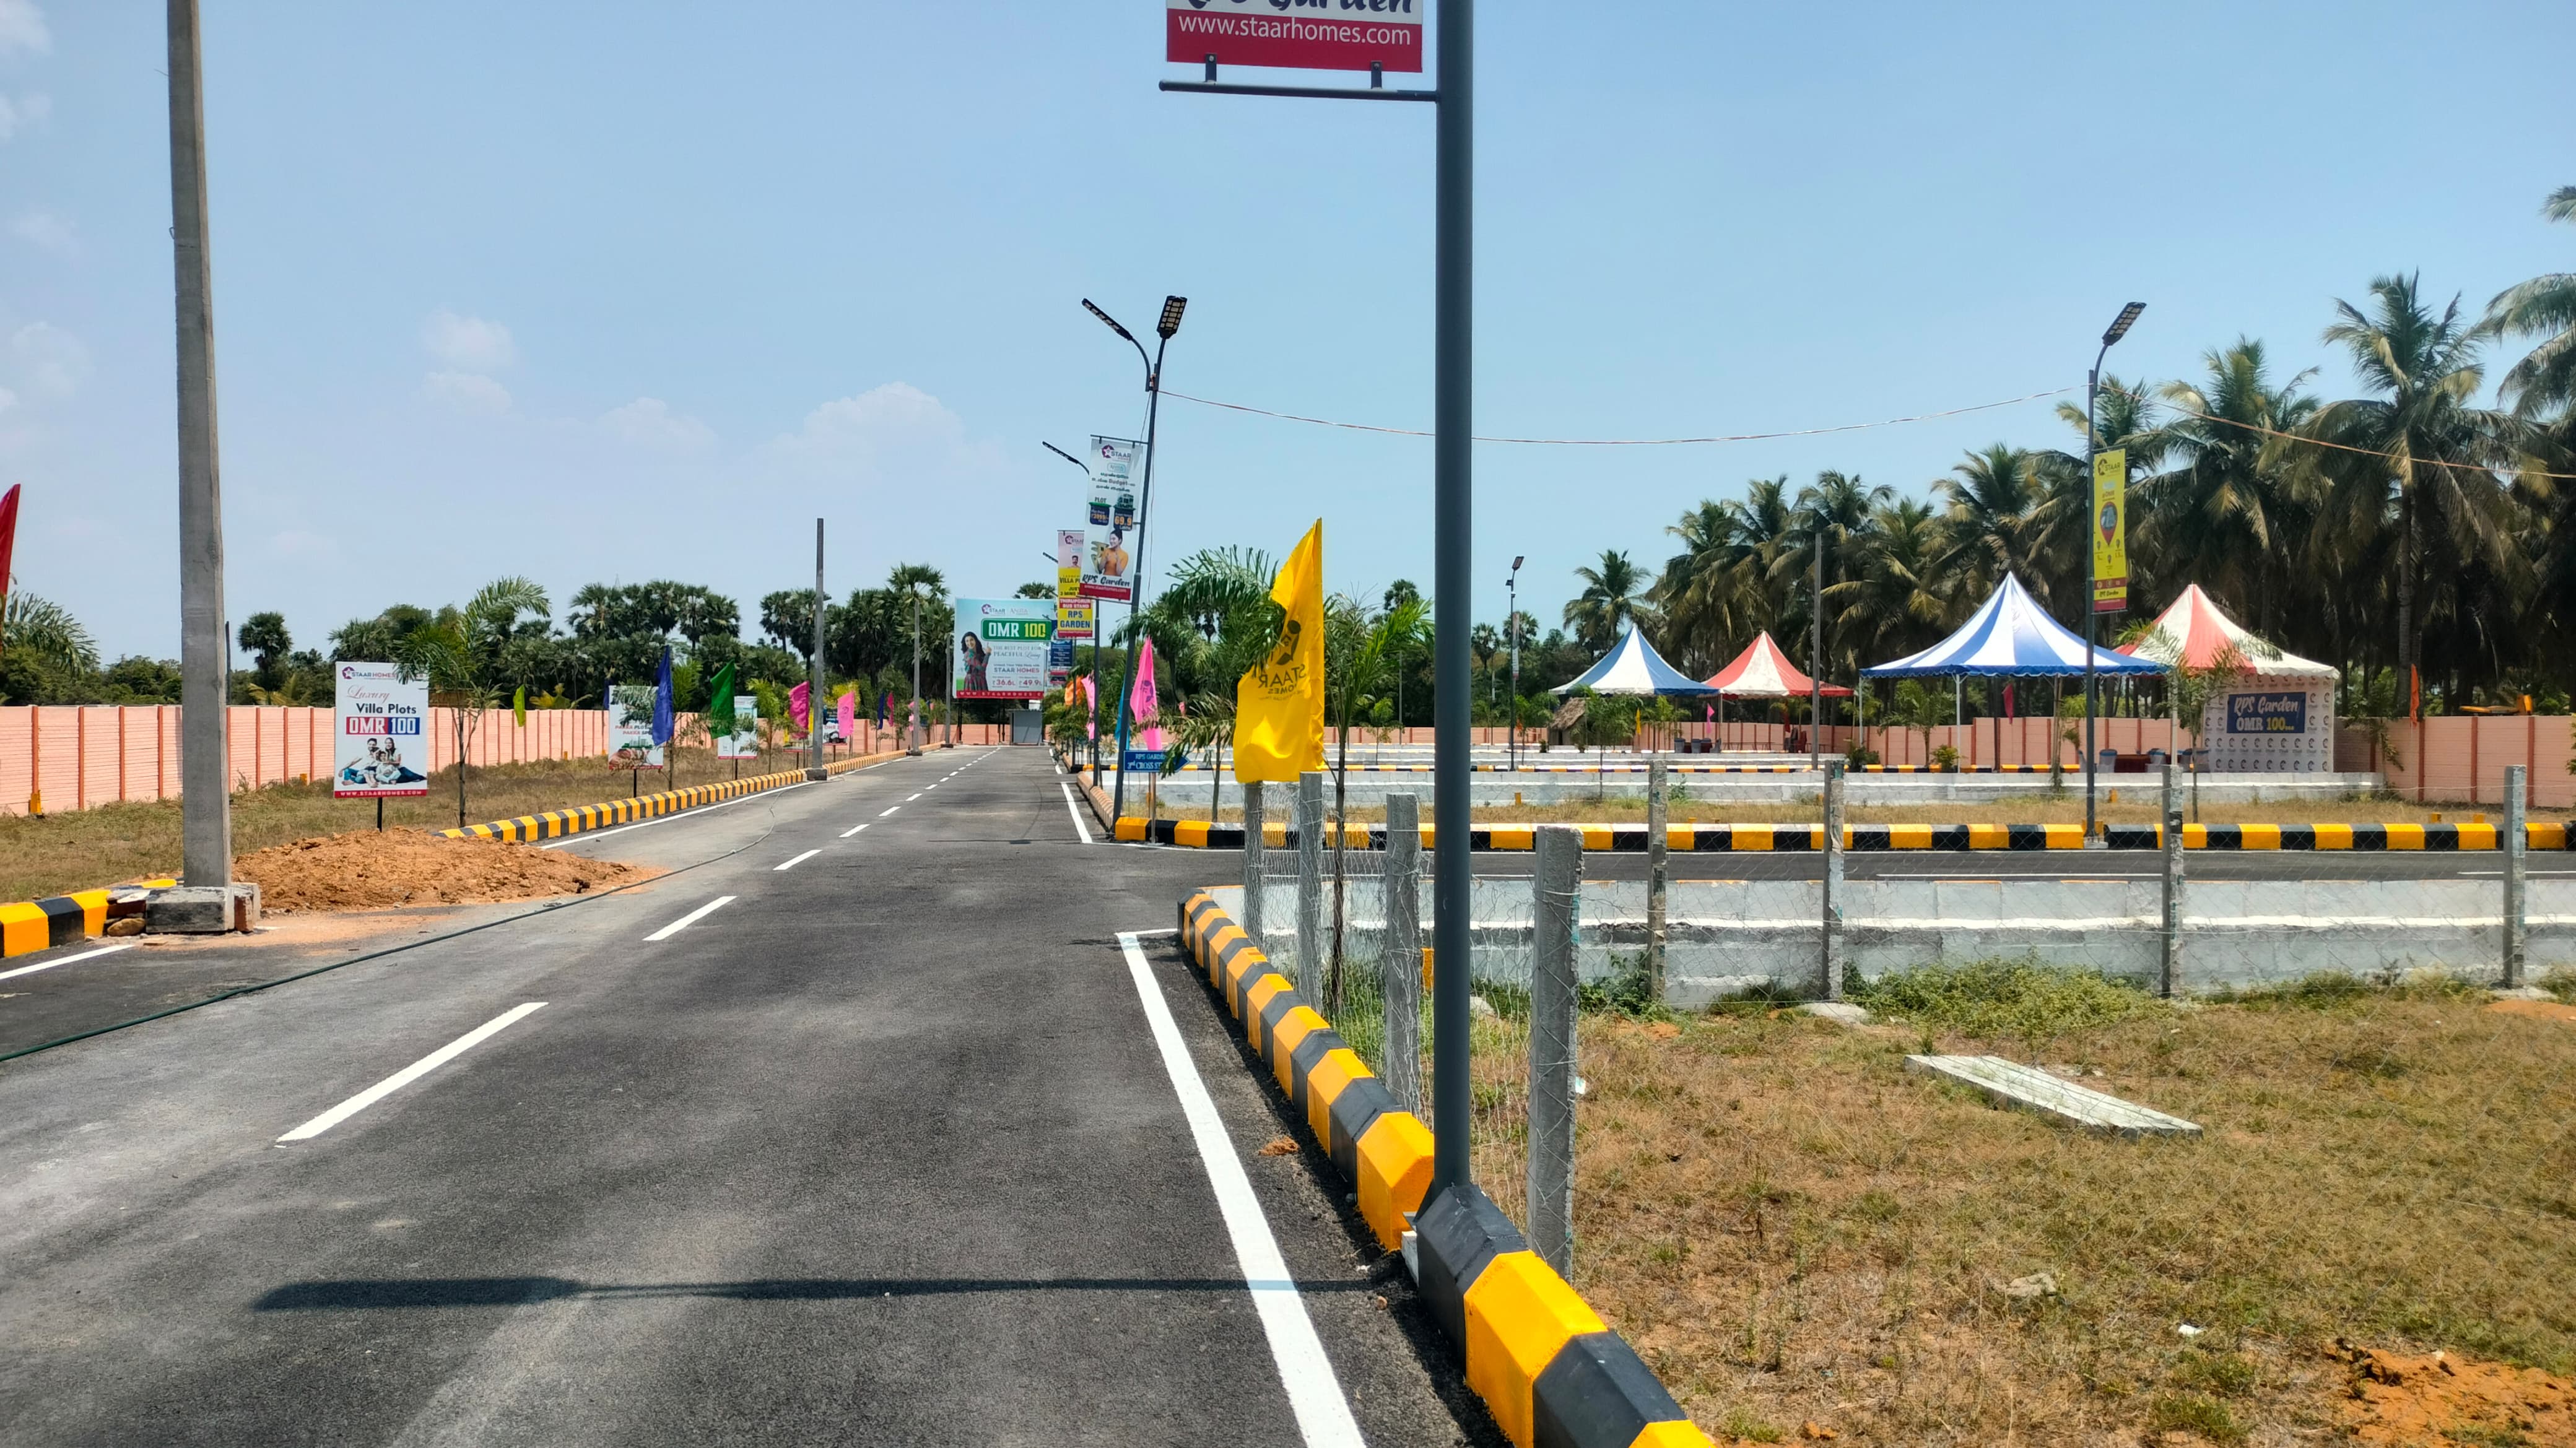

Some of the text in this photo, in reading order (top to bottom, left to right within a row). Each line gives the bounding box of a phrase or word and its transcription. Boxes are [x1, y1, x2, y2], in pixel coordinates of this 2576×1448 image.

[1178, 15, 1411, 45] www.staarhomes.com
[1082, 574, 1098, 584] RPS
[1100, 576, 1130, 586] Garden
[988, 622, 1046, 638] OMR 100
[1060, 620, 1090, 628] GARDEN
[347, 685, 390, 703] Luxury
[356, 703, 417, 714] Villa Plots
[2234, 695, 2299, 716] RPS Garden
[349, 717, 416, 734] OMR 100
[2236, 717, 2263, 731] OMR
